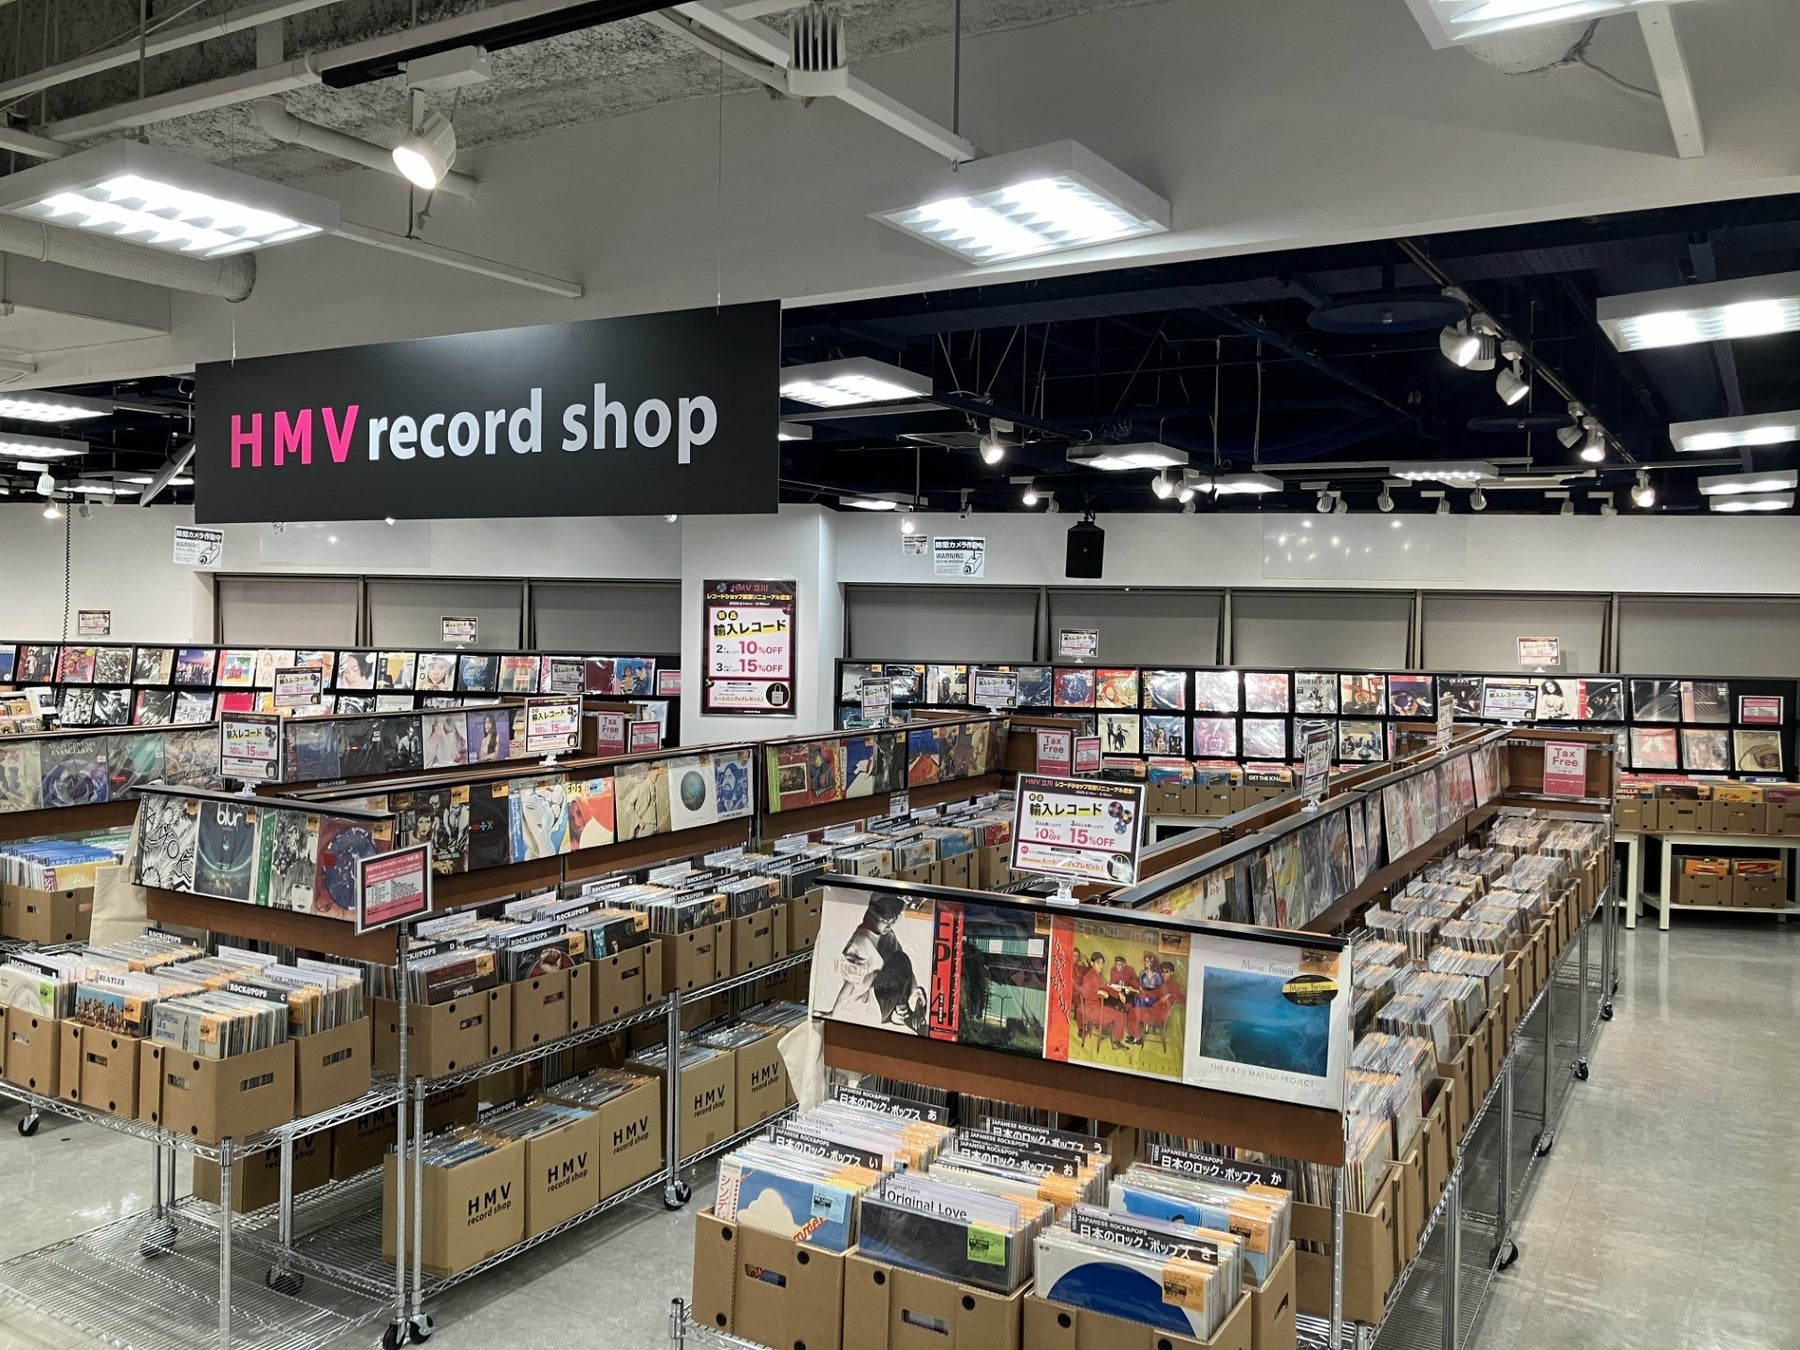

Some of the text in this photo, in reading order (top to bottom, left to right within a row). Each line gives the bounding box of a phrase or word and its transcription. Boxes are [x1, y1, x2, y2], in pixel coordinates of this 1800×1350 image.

[231, 383, 717, 468] HMV record shop
[713, 619, 787, 637] 輸入レコード
[602, 725, 619, 734] Free
[604, 717, 617, 726] Tax
[1043, 744, 1064, 755] Free
[1044, 735, 1062, 745] Tax
[1552, 756, 1579, 767] Free
[1554, 748, 1576, 758] Tax
[217, 803, 242, 826] blur
[1029, 803, 1103, 817] 輸入レコード
[556, 906, 589, 921] ROCK&POPS
[407, 947, 437, 961] CK&POPS
[230, 983, 286, 1001] ROCK&POPS C
[751, 1061, 780, 1086] HMV
[1210, 1063, 1314, 1087] THE KAZU MATSUI PROJECT
[693, 1085, 726, 1110] HMV
[839, 1086, 890, 1102] JAPANESE ROCK&POPS
[840, 1093, 937, 1121] 日本のロック・ポップス あ
[613, 1116, 649, 1146] HMV
[776, 1128, 830, 1147] JAPANESE ROCK&POPS
[992, 1119, 1050, 1135] JAPANESE ROCK&POPS
[613, 1131, 649, 1156] record shop
[960, 1140, 985, 1151] JAPANESE
[986, 1145, 1019, 1157] ROCK&POPS
[970, 1131, 1029, 1149] JAPANESE ROCK&POPS
[993, 1126, 1102, 1154] 日本のロック・ポップス う
[776, 1135, 879, 1169] 日本のロック・ポップス い
[960, 1148, 1074, 1177] 日本のロック・ポップス お
[1160, 1147, 1188, 1158] JAPANESE
[1189, 1152, 1224, 1165] ROCK&POPS
[547, 1152, 588, 1184] HMV
[1161, 1155, 1282, 1186] 日本のロック・ポップス か
[547, 1169, 588, 1193] record shop
[467, 1181, 512, 1217] HMV
[887, 1190, 967, 1220] Original Love
[467, 1200, 512, 1226] record shop
[1078, 1216, 1108, 1228] JAPANESE
[1109, 1222, 1148, 1236] ROCK&POPS
[1080, 1224, 1190, 1260] 日本のロック・ポップス
